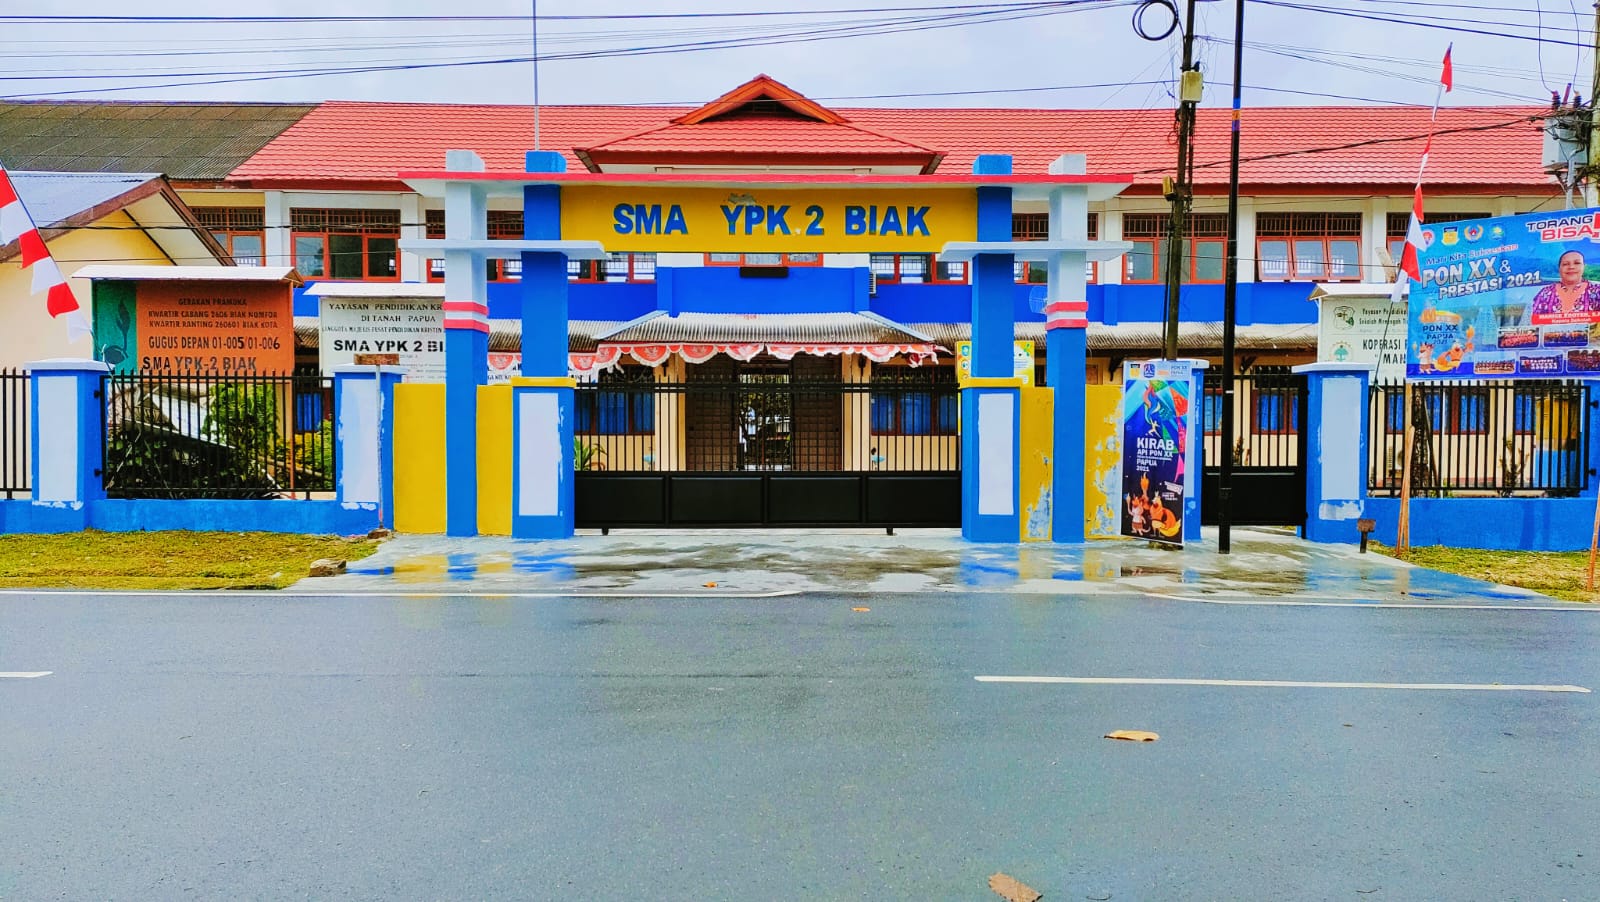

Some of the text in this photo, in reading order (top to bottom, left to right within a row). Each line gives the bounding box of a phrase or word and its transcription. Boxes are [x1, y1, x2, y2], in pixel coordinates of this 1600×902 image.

[612, 203, 689, 235] SMA
[844, 205, 931, 237] BIAK
[1527, 215, 1593, 231] TORANG
[1426, 256, 1447, 265] Mari
[1449, 252, 1467, 262] Kita
[1422, 256, 1512, 289] PON XX &
[1438, 270, 1542, 300] PRESTASI 2021
[178, 298, 247, 306] GERAKAN PRAMUKA
[329, 303, 369, 311] YAYASAN
[374, 303, 429, 311] PENDIDIKAN
[1422, 324, 1443, 332] PON
[148, 336, 178, 349] GUGUS
[181, 336, 209, 349] DEPAN
[333, 339, 444, 353] SMA YPK 2 BI
[1362, 339, 1401, 350] KOPERASI
[142, 356, 257, 370] SMA YPK-2 BIAK
[1136, 437, 1175, 451] KIRAB
[1136, 458, 1157, 466] PAPUA
